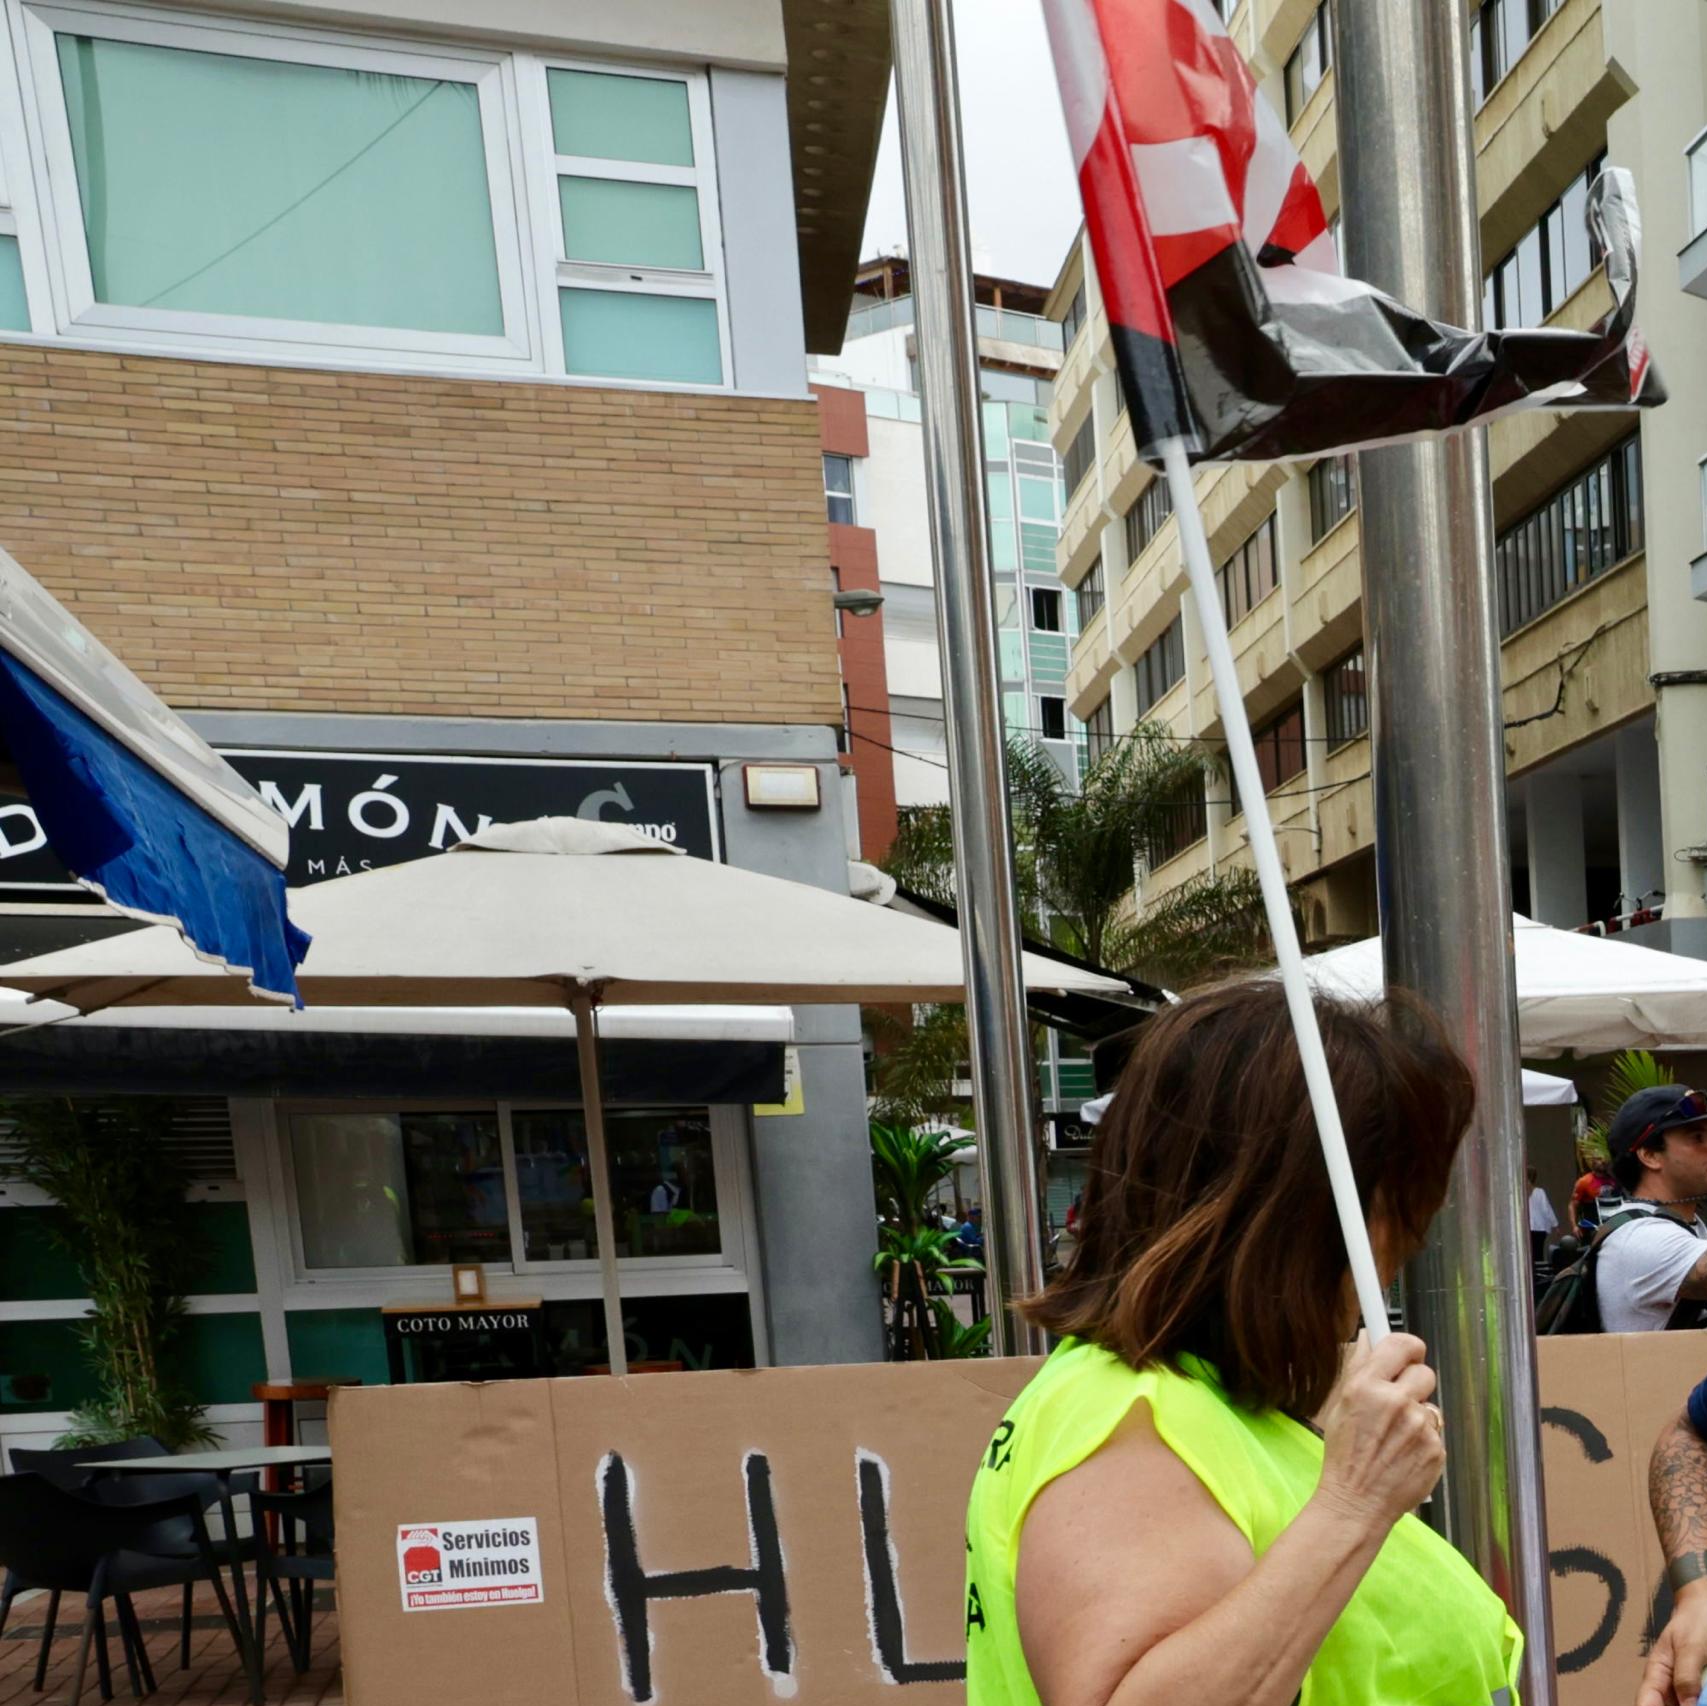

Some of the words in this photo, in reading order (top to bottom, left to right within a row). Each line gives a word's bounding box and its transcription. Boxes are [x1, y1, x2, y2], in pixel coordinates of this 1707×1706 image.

[396, 1317, 451, 1333] COTO
[458, 1314, 529, 1331] MAYOR
[442, 1527, 531, 1551] Servicios
[407, 1569, 441, 1584] CGT
[449, 1557, 530, 1579] Mínimos
